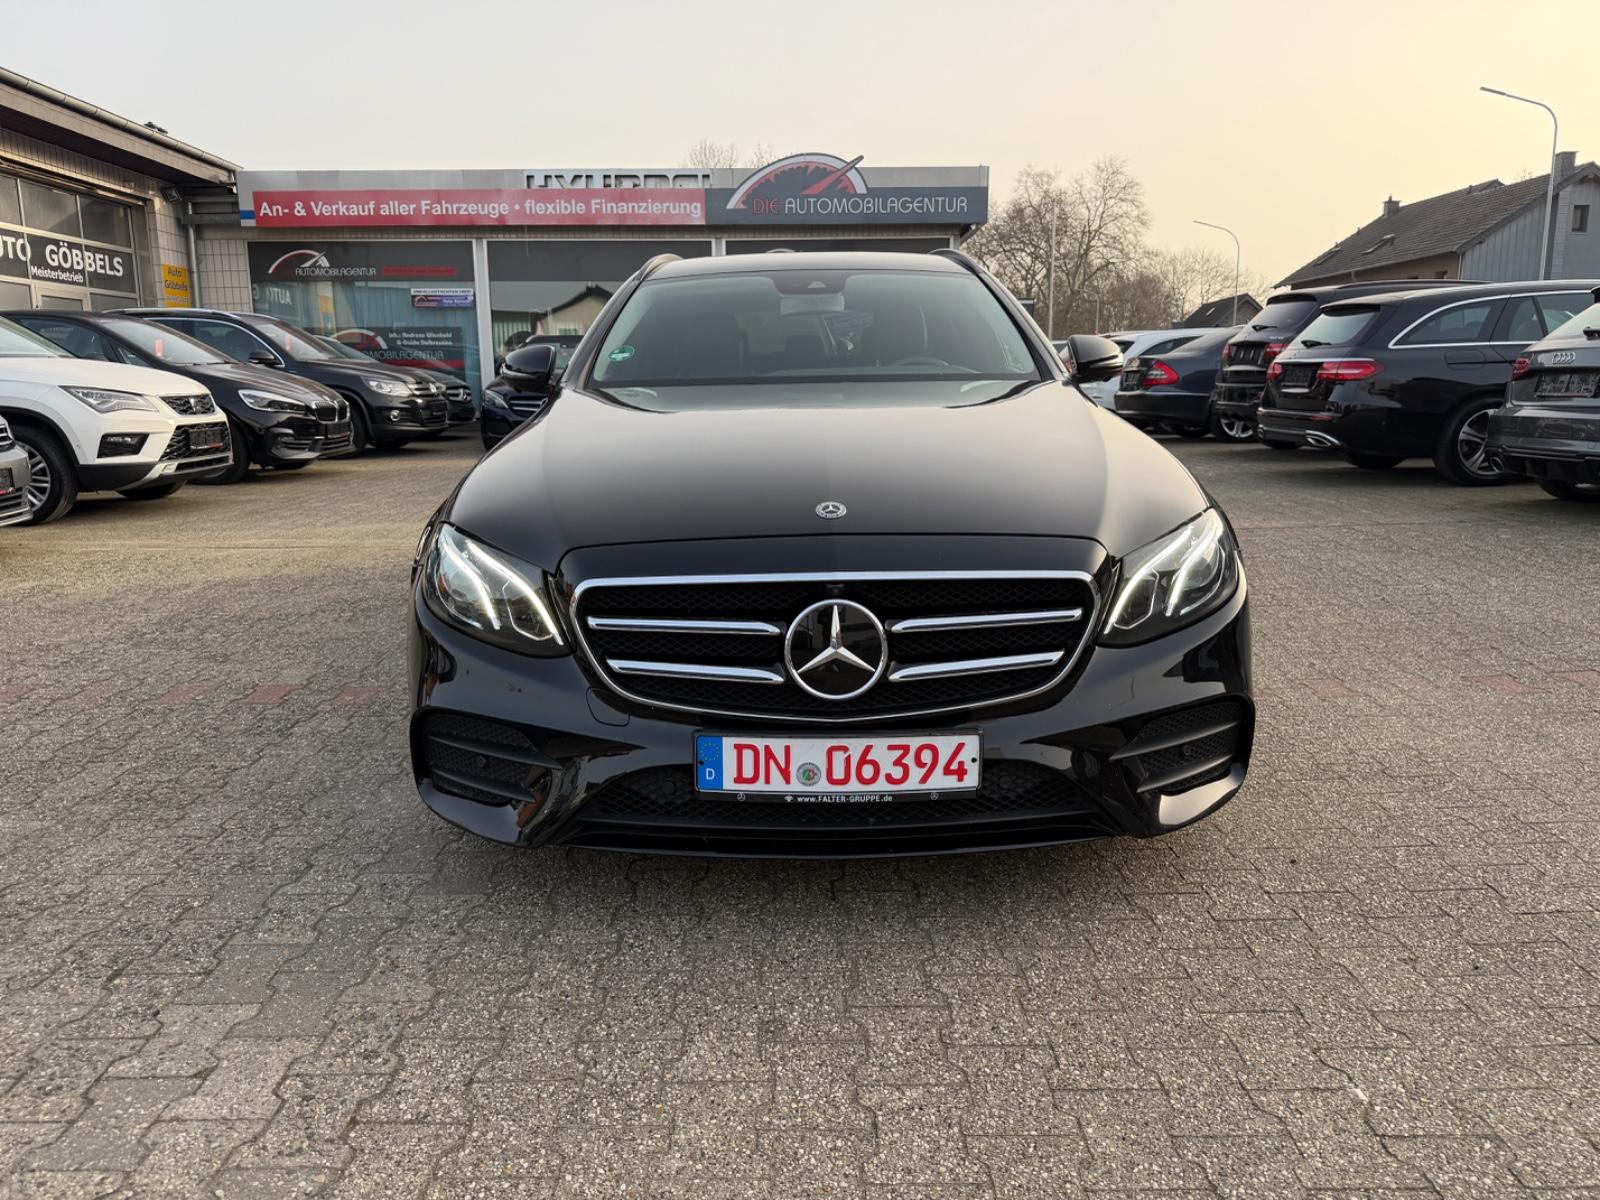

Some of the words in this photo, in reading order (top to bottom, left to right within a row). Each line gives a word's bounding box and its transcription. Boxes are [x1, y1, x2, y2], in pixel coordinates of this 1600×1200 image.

[260, 201, 289, 216] An-
[294, 201, 306, 216] &
[310, 200, 375, 217] Verkauf
[380, 200, 416, 216] aller
[421, 199, 509, 218] Fahrzeuge
[524, 199, 586, 215] flexible
[591, 199, 702, 217] Finanzierung
[752, 198, 780, 214] DIE
[784, 197, 968, 214] AUTOMOBILAGENTUR
[45, 242, 123, 277] GÖBBELS
[31, 265, 84, 283] Meisterbetrieb
[733, 743, 791, 785] DN
[826, 742, 968, 786] 06394
[706, 769, 715, 780] D
